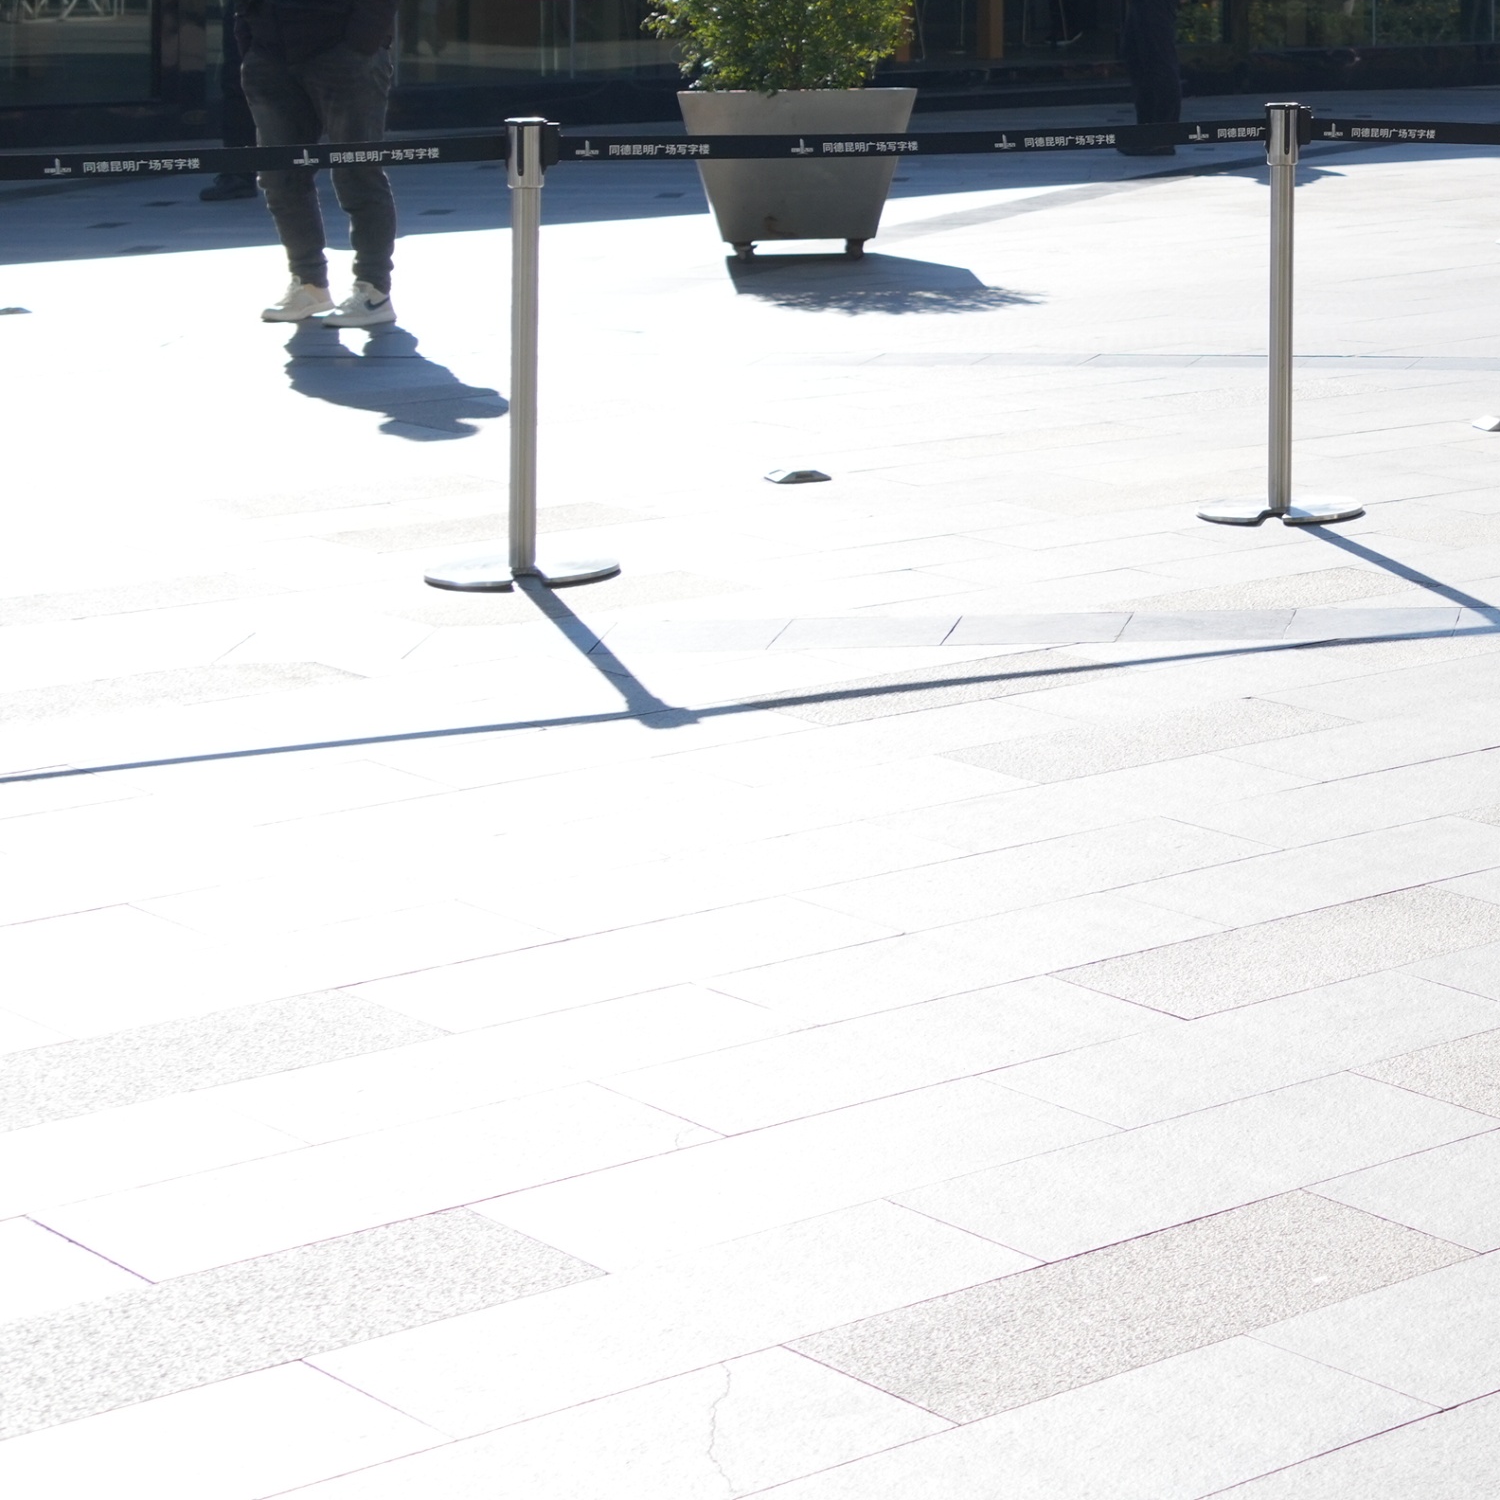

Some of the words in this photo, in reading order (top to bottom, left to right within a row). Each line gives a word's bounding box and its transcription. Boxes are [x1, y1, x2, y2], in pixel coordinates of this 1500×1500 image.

[1351, 127, 1436, 140] 同德昆明广场写字楼
[823, 140, 919, 153] 同德昆明广场写字楼
[1024, 133, 1116, 149] 同德昆明广场写字楼
[329, 147, 441, 164] 同德昆明广场写字楼
[609, 143, 710, 156] 同德昆明广场写字楼
[83, 157, 200, 174] 同德昆明广场写字楼
